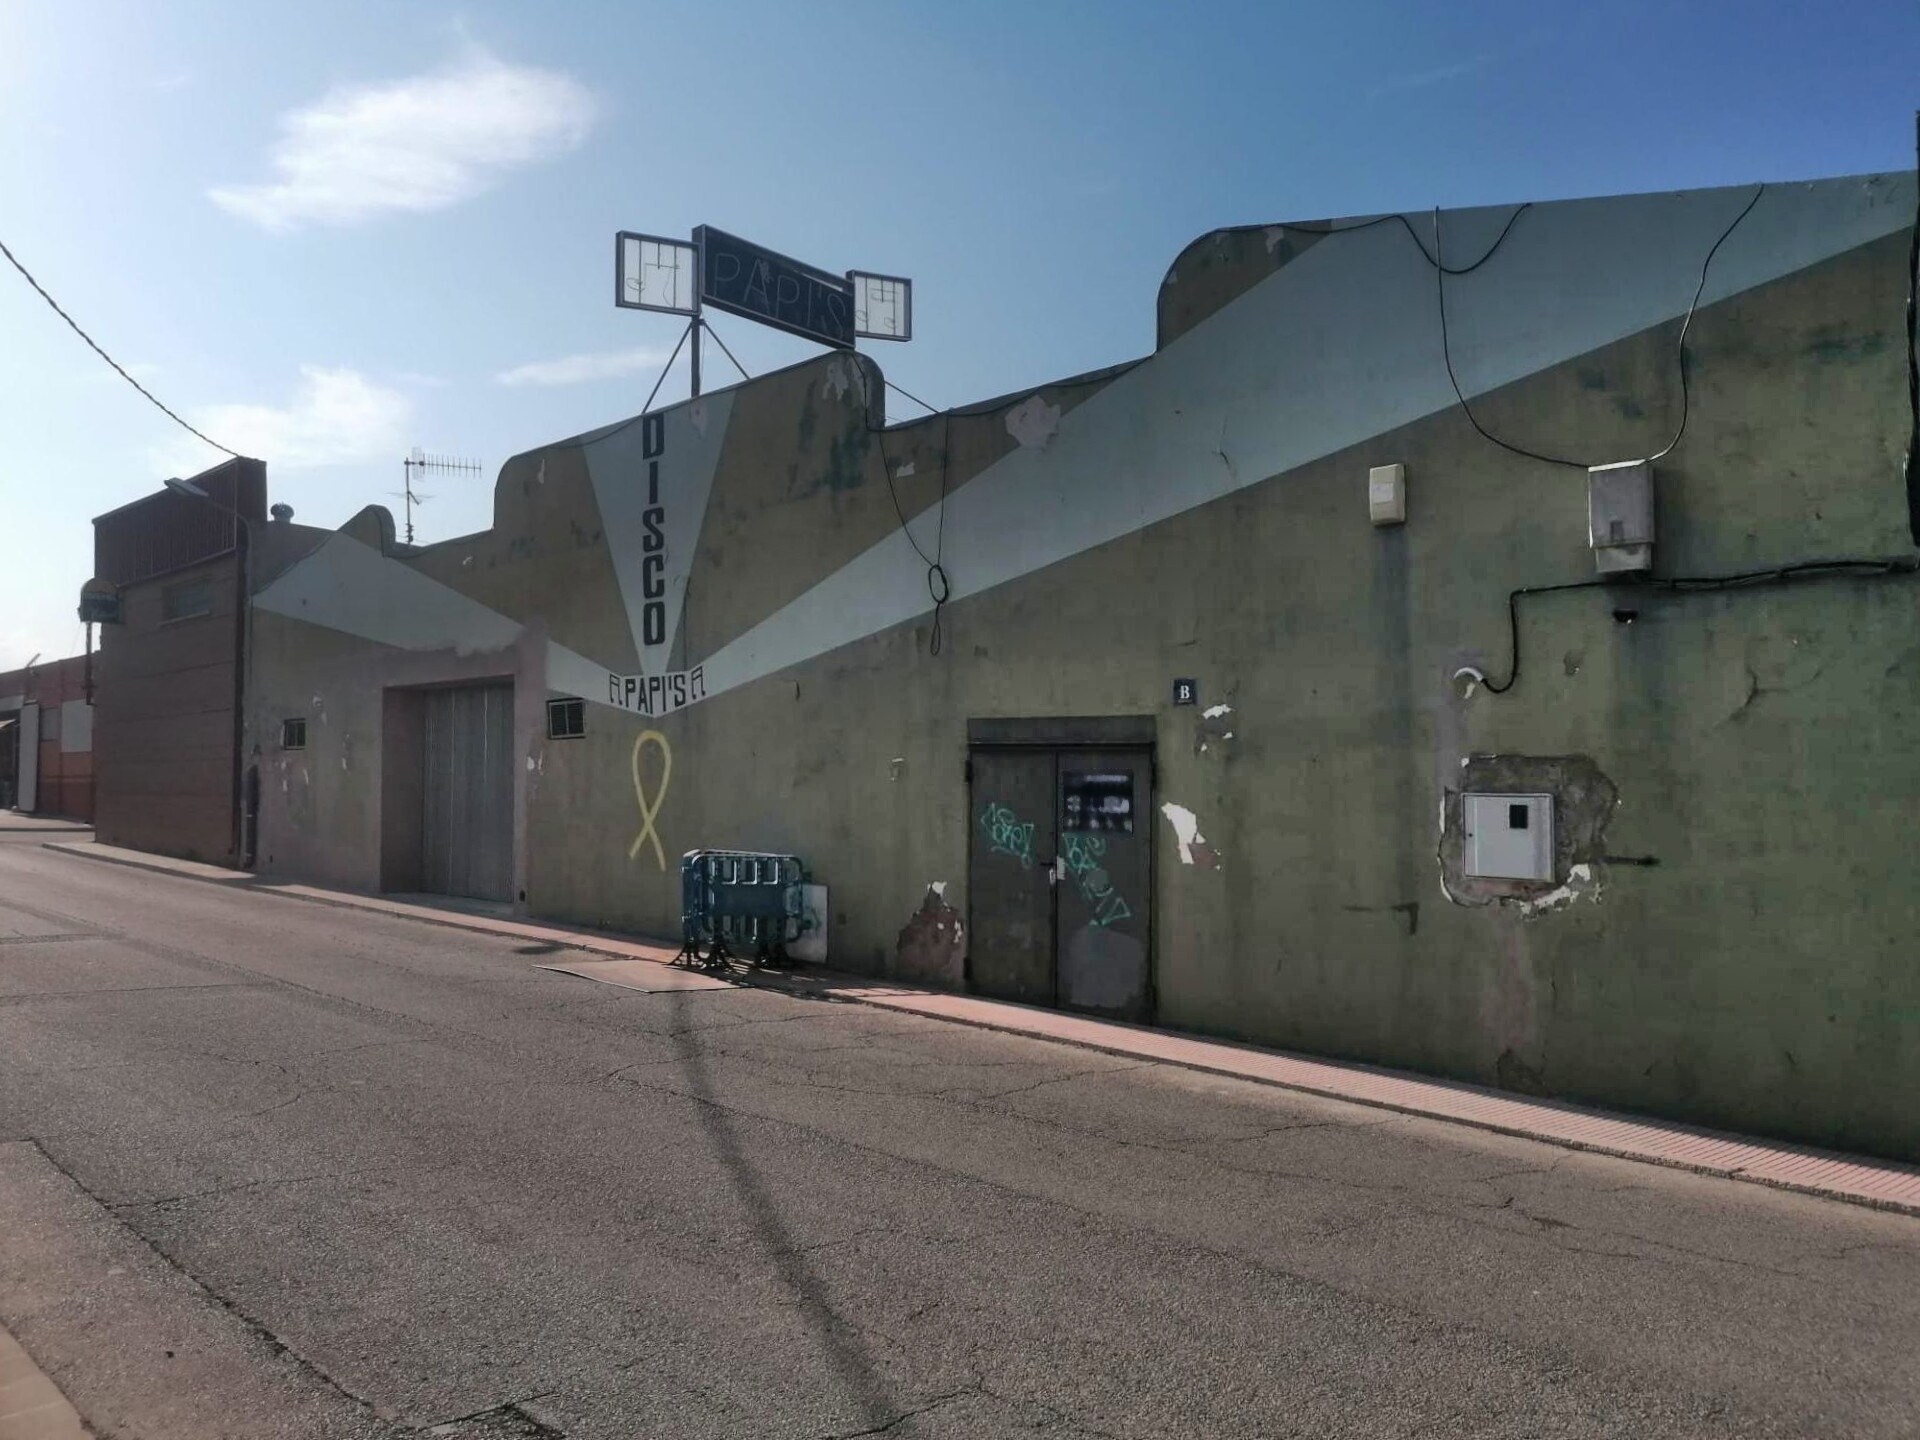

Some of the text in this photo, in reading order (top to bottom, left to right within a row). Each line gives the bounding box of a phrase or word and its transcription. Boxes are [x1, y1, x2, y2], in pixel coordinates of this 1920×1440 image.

[714, 252, 847, 339] PAPI'S
[642, 412, 666, 647] DISCO
[625, 674, 686, 714] PAPI'S
[1180, 685, 1190, 699] B
